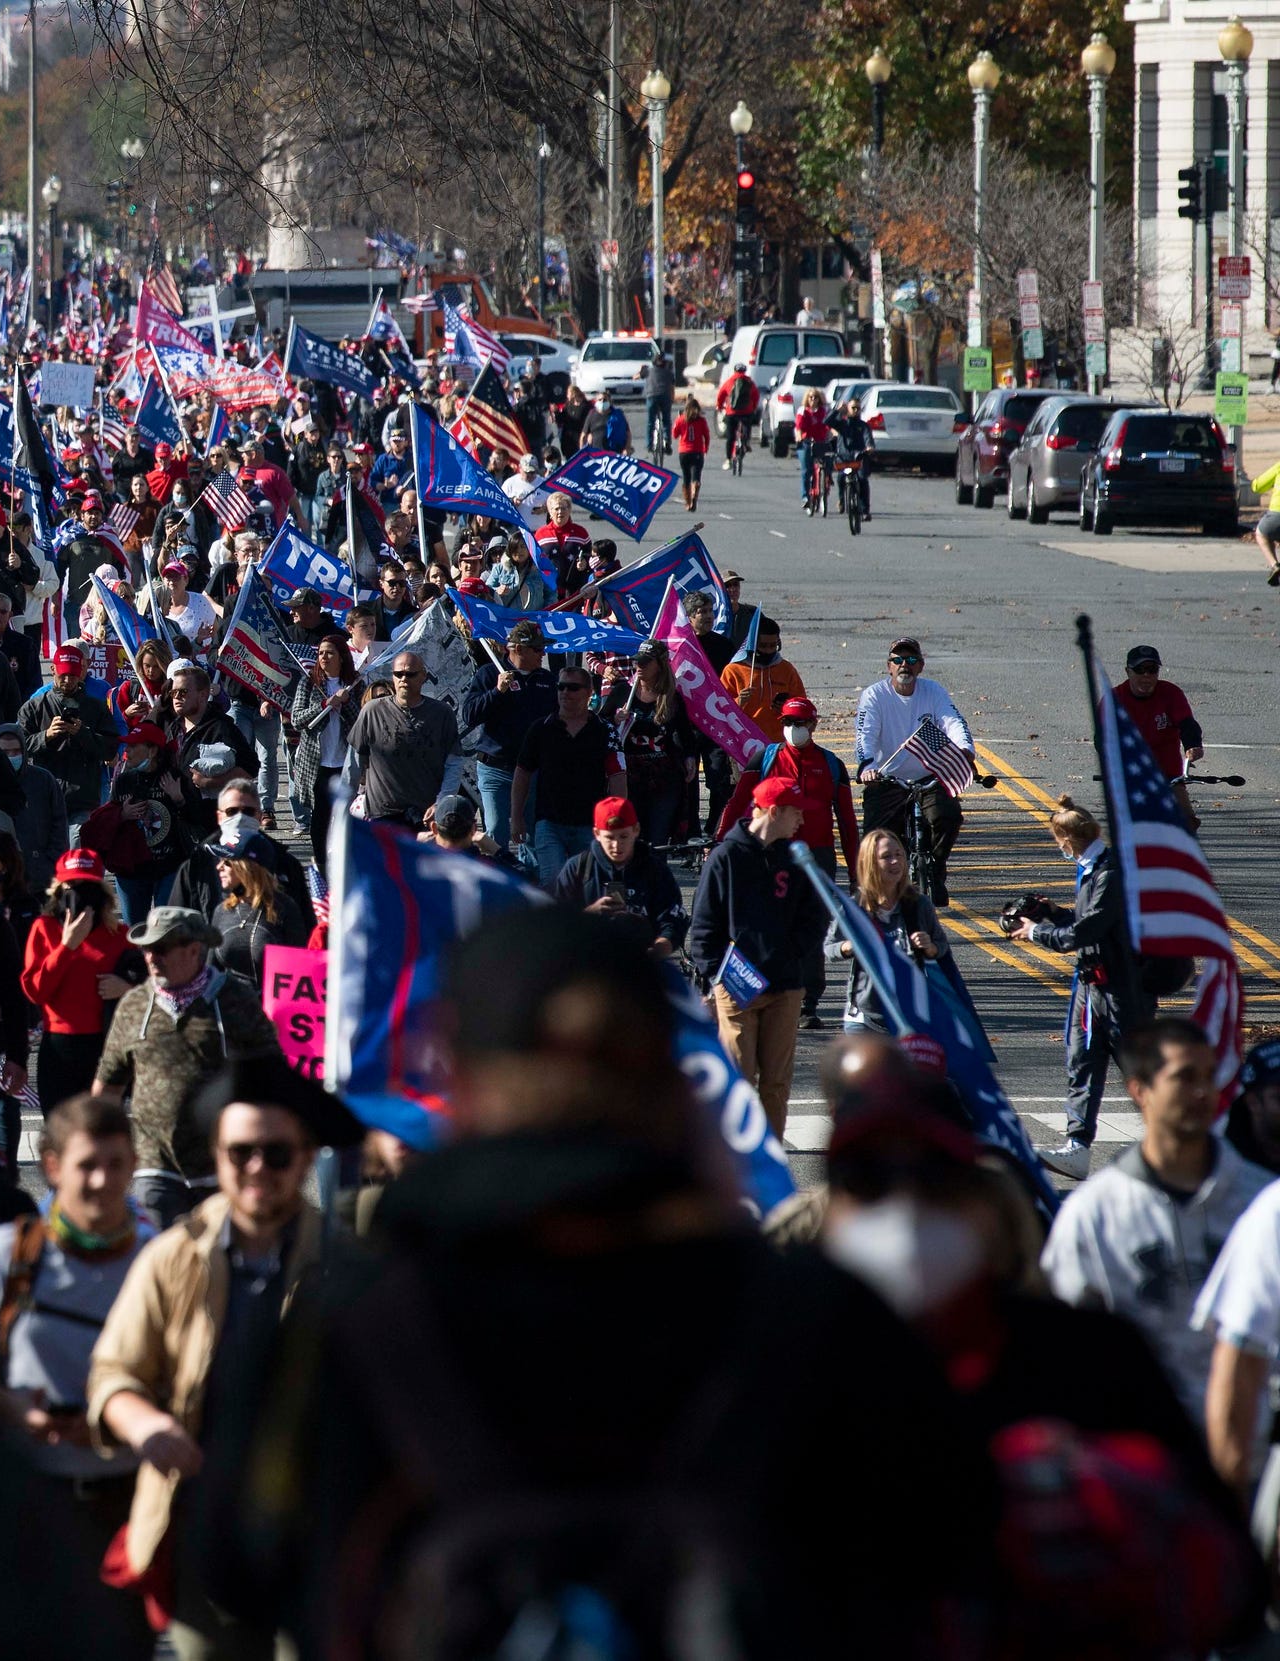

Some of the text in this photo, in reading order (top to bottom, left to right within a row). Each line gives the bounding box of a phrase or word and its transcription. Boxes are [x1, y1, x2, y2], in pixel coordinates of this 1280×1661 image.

[306, 339, 374, 376] TRUMP
[435, 484, 472, 494] KEEP
[556, 476, 579, 490] KEEP
[625, 592, 651, 628] KEEP
[236, 644, 250, 660] the
[226, 654, 247, 676] right
[775, 870, 790, 898] S
[728, 953, 764, 990] TRUMP
